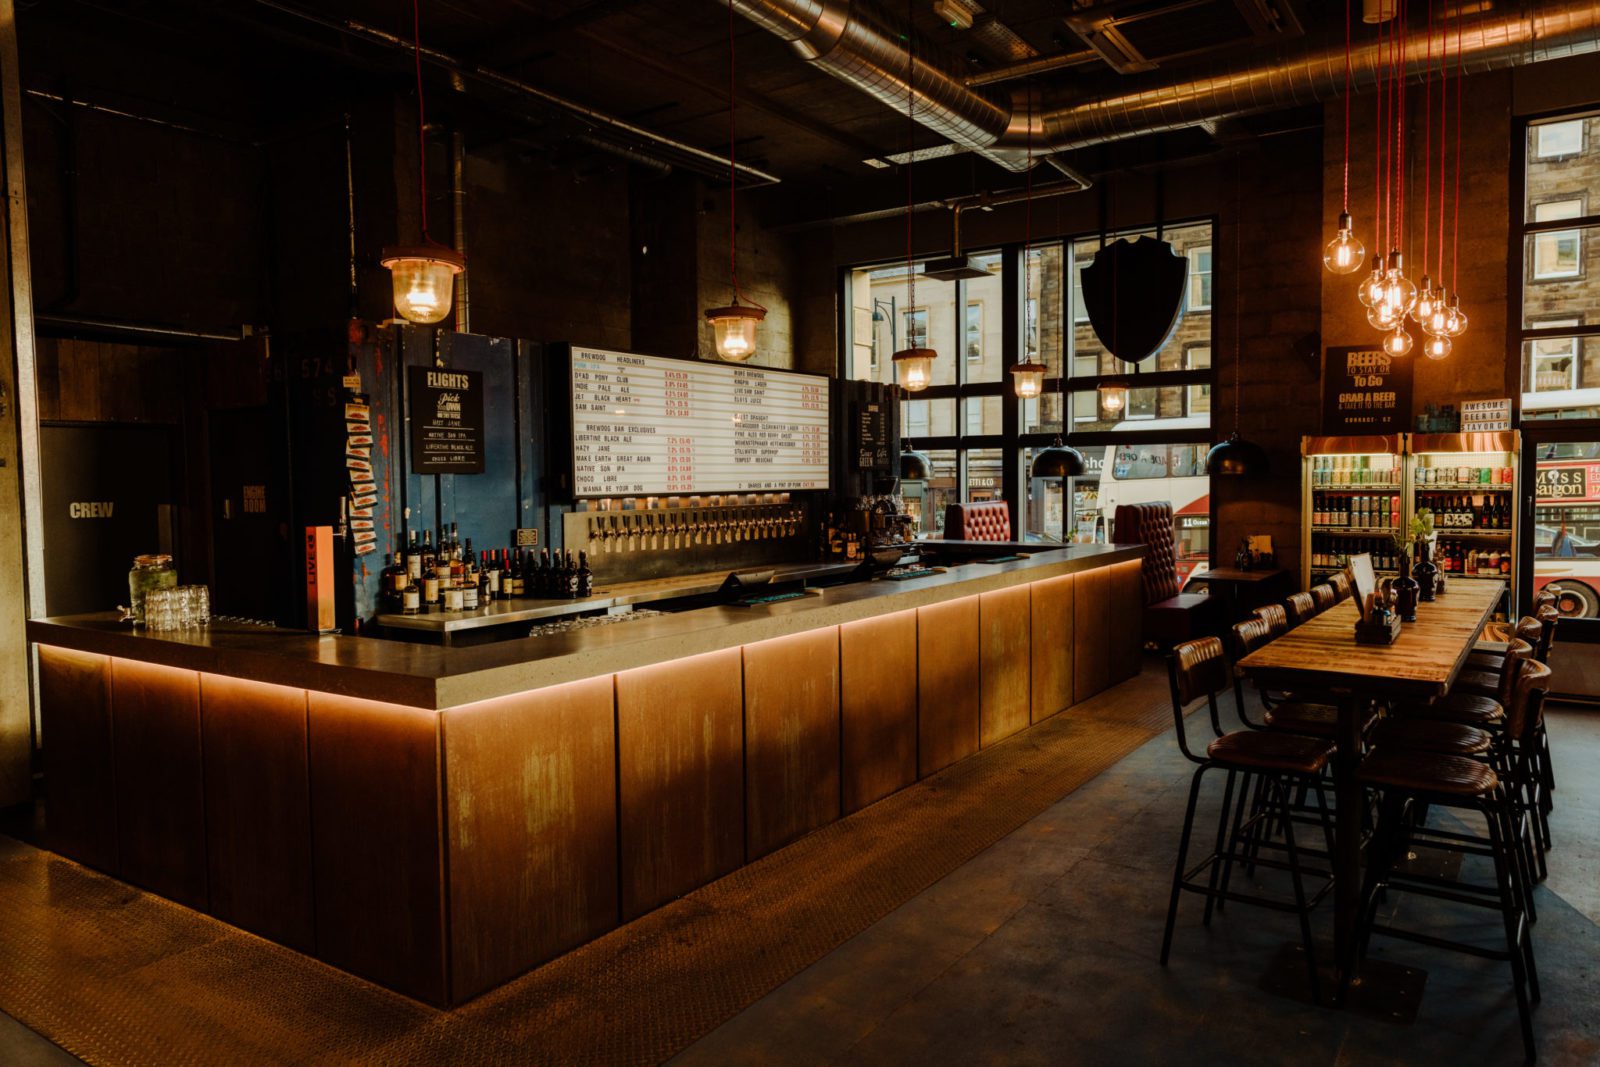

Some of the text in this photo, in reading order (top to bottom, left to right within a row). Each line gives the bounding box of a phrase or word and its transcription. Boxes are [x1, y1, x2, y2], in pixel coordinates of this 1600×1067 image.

[617, 356, 645, 366] HEADLINERS
[1347, 351, 1391, 368] BEERS
[427, 371, 469, 389] FLIGHTS
[575, 372, 589, 380] DEAD
[1354, 375, 1383, 387] To Go
[1338, 392, 1396, 403] GRAB A BEER
[1465, 401, 1504, 410] AWESOME
[70, 501, 114, 519] CREW
[244, 499, 266, 513] ROOM
[1183, 518, 1192, 527] 11
